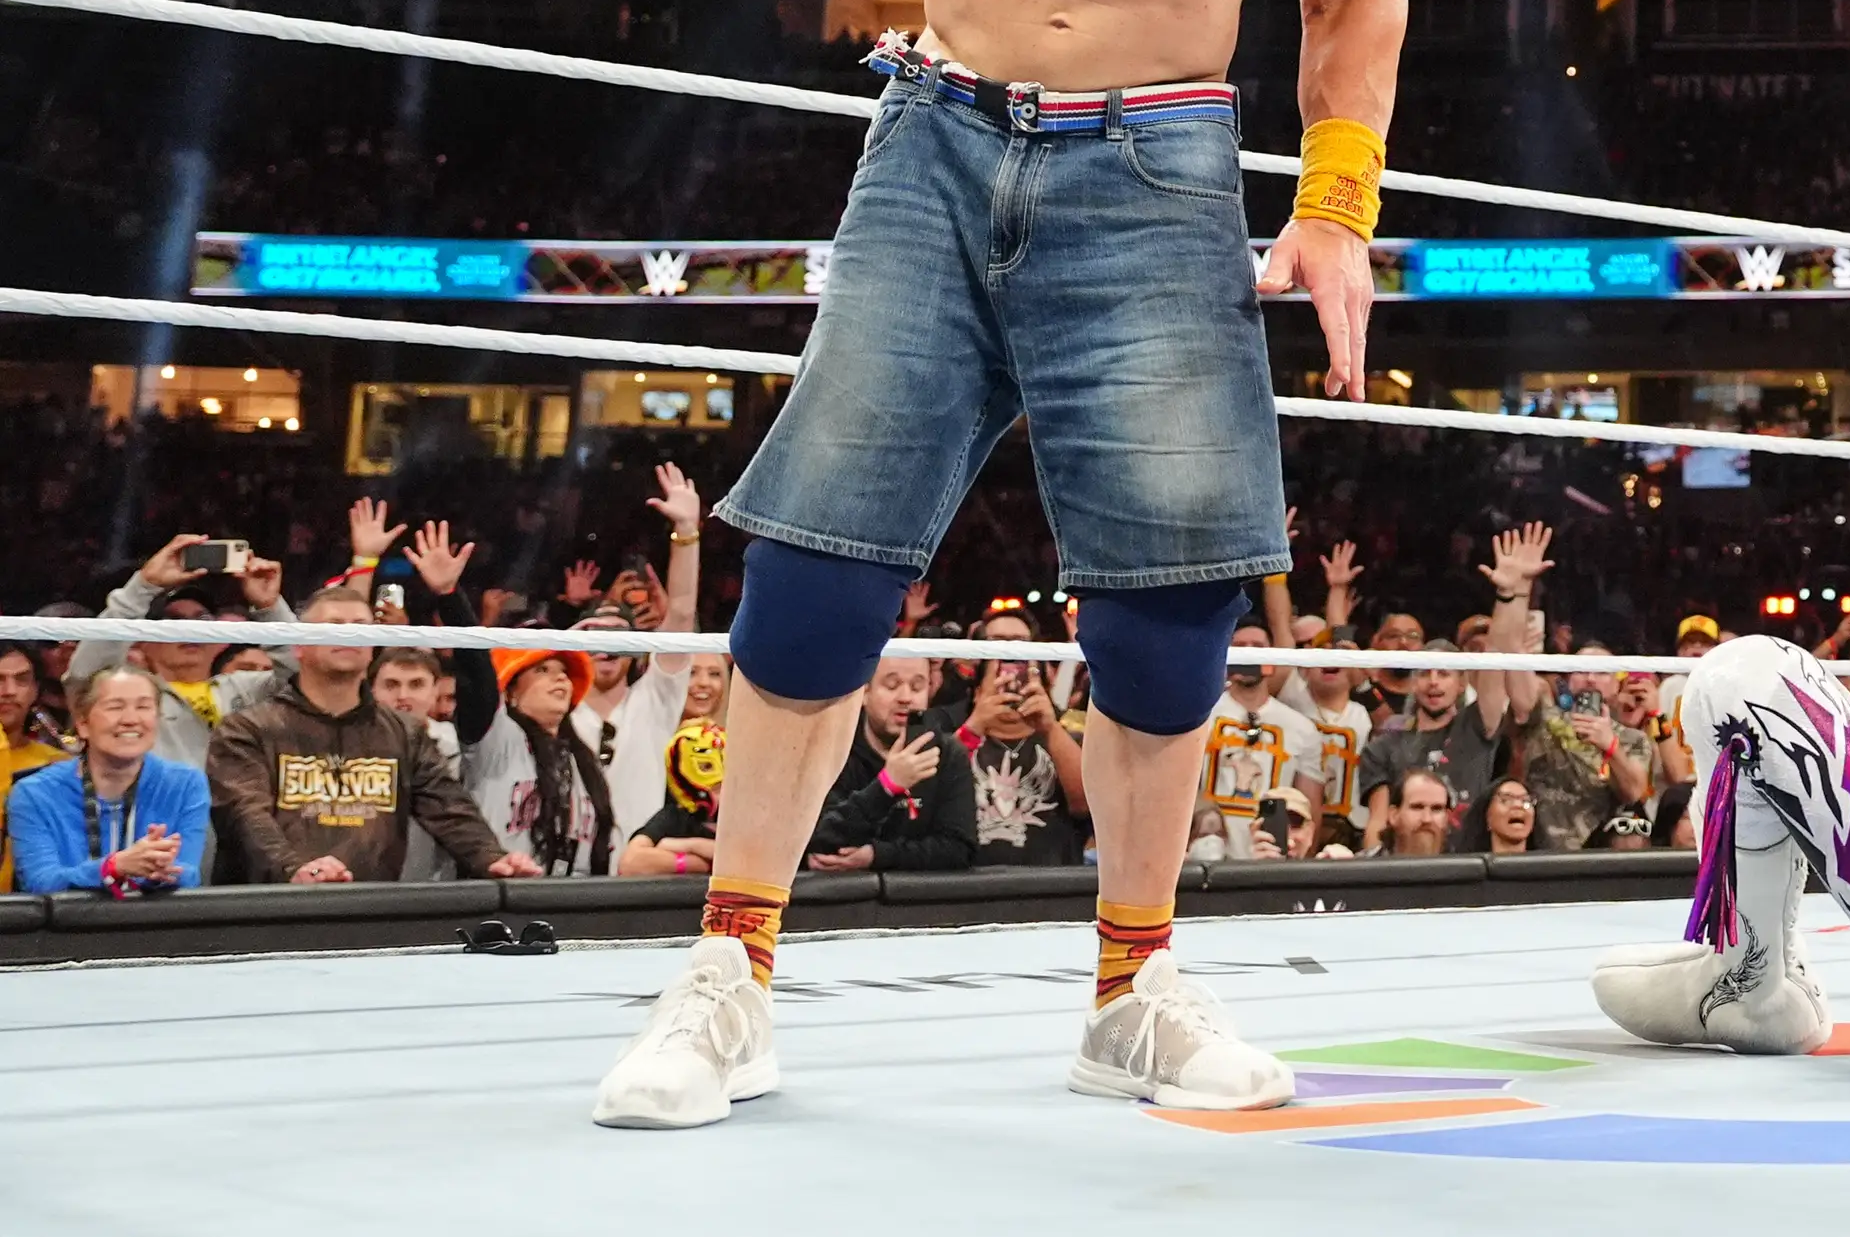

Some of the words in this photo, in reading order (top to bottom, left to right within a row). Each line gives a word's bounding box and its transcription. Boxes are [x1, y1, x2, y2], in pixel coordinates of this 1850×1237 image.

[1337, 176, 1356, 190] up
[1329, 185, 1362, 203] give
[1321, 196, 1363, 216] never
[284, 768, 393, 801] SURVIVOR
